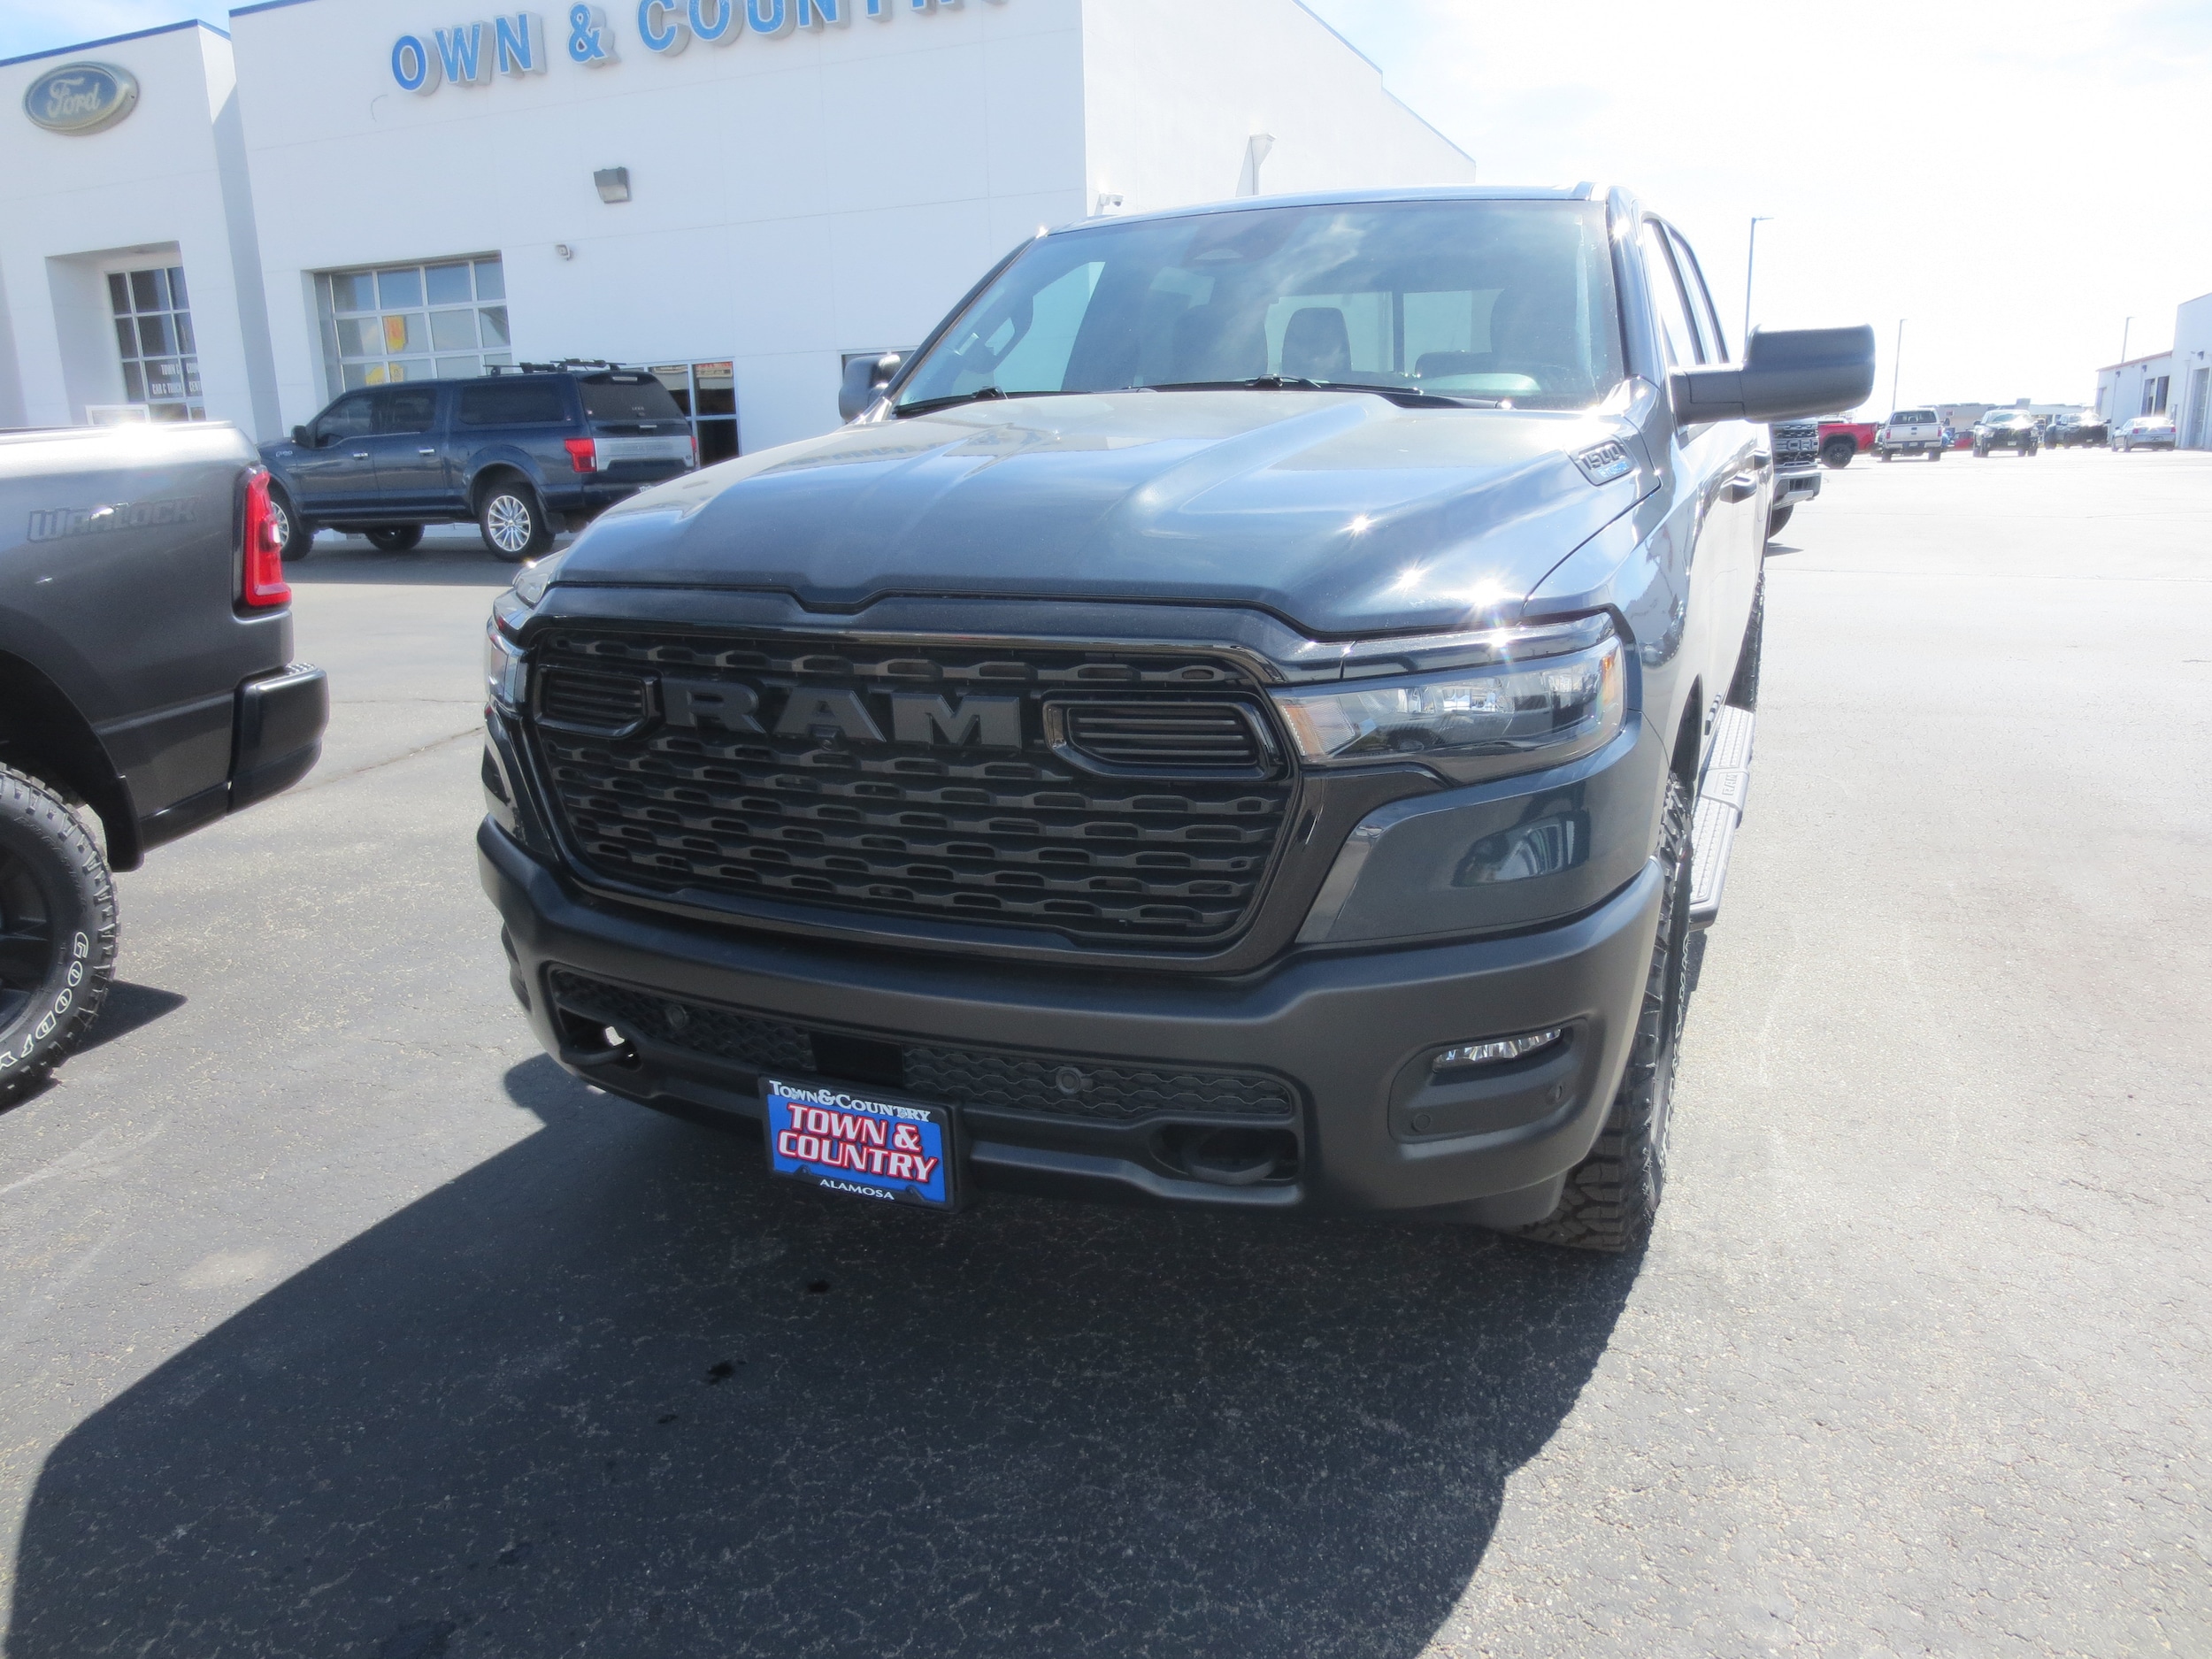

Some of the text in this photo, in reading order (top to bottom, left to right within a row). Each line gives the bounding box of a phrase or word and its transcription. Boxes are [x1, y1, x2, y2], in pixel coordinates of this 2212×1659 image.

[391, 12, 534, 91] OWN
[567, 3, 608, 64] &
[46, 77, 102, 118] Ford
[1585, 443, 1621, 470] 1500
[662, 677, 1023, 749] RAM
[787, 1102, 923, 1154] TOWN &
[778, 1129, 939, 1184] COUNTRY
[819, 1179, 895, 1201] ALAMOSA
